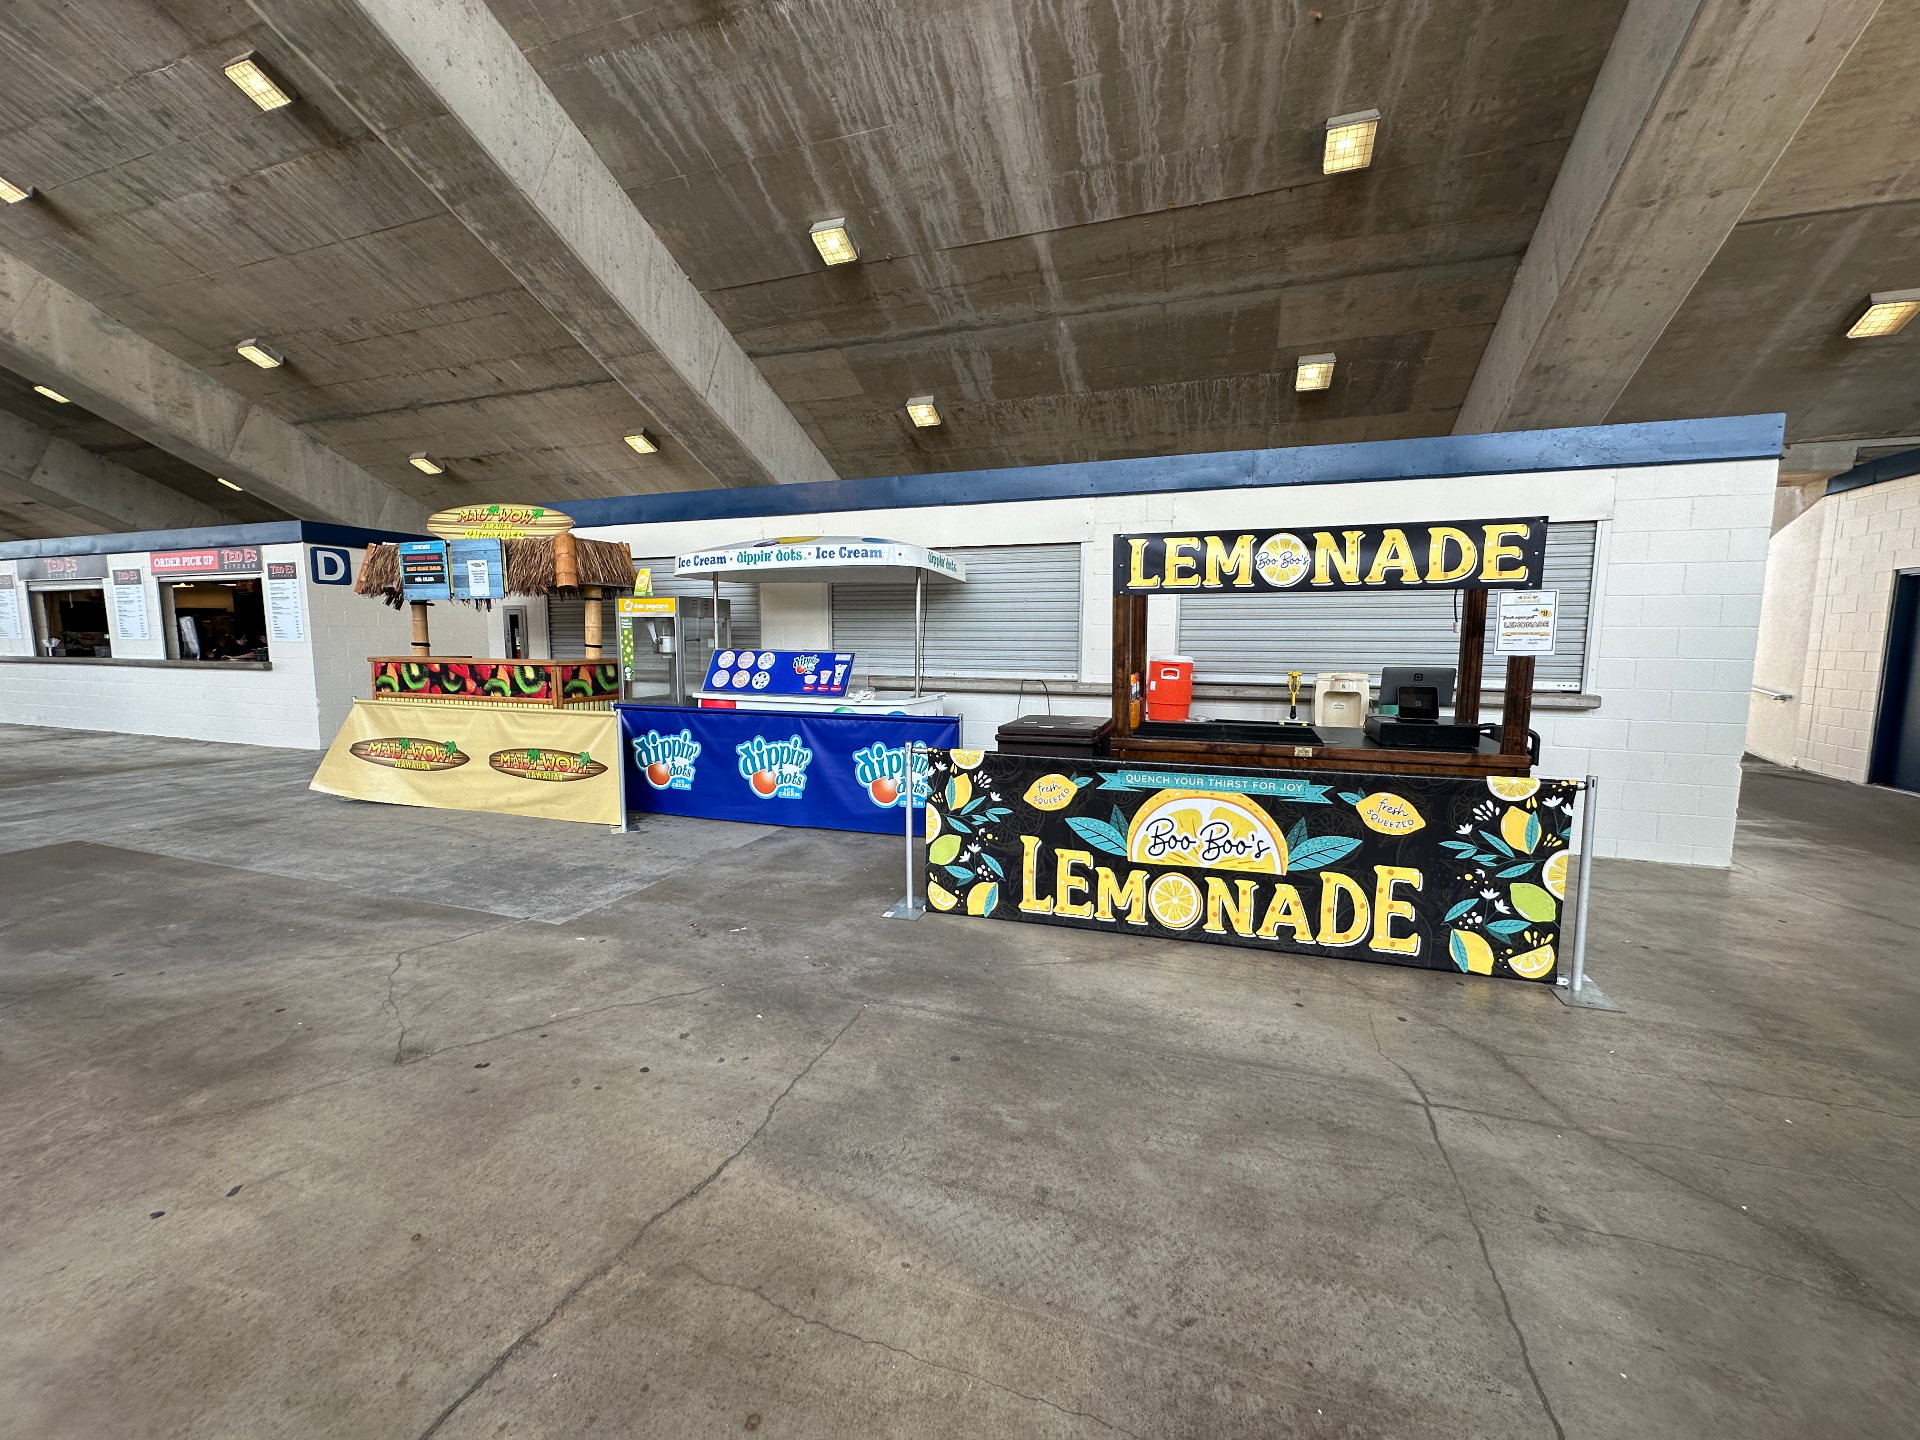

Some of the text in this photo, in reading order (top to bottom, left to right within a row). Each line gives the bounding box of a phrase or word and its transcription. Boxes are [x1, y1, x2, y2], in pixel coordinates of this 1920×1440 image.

[154, 555, 214, 568] ORDER PICK UP
[221, 549, 243, 564] TED
[678, 546, 883, 569] Ice Cream dippin' dots Ice Cream
[1126, 523, 1530, 588] LEMONADE
[1256, 550, 1311, 569] Boo Boo's
[316, 551, 345, 581] D
[1503, 621, 1549, 629] LEMONADE
[366, 738, 410, 758] MAUI
[635, 733, 698, 768] dippin'
[740, 739, 809, 776] dippin'
[394, 760, 431, 771] HAWAIIAN
[498, 749, 540, 770] MAUI
[525, 770, 564, 781] HAWAIIAN
[669, 763, 692, 778] dots
[776, 770, 803, 785] dots
[897, 778, 926, 794] dts
[1036, 781, 1063, 796] fresh
[1125, 774, 1304, 793] QUENCH YOUR THIRST FOR JOY
[1032, 788, 1070, 805] SQUEEZED
[1378, 798, 1410, 817] fresh
[1366, 809, 1415, 829] SQUEEZED
[1146, 818, 1271, 862] Boo Boo's
[1018, 835, 1422, 958] LEMONADE
